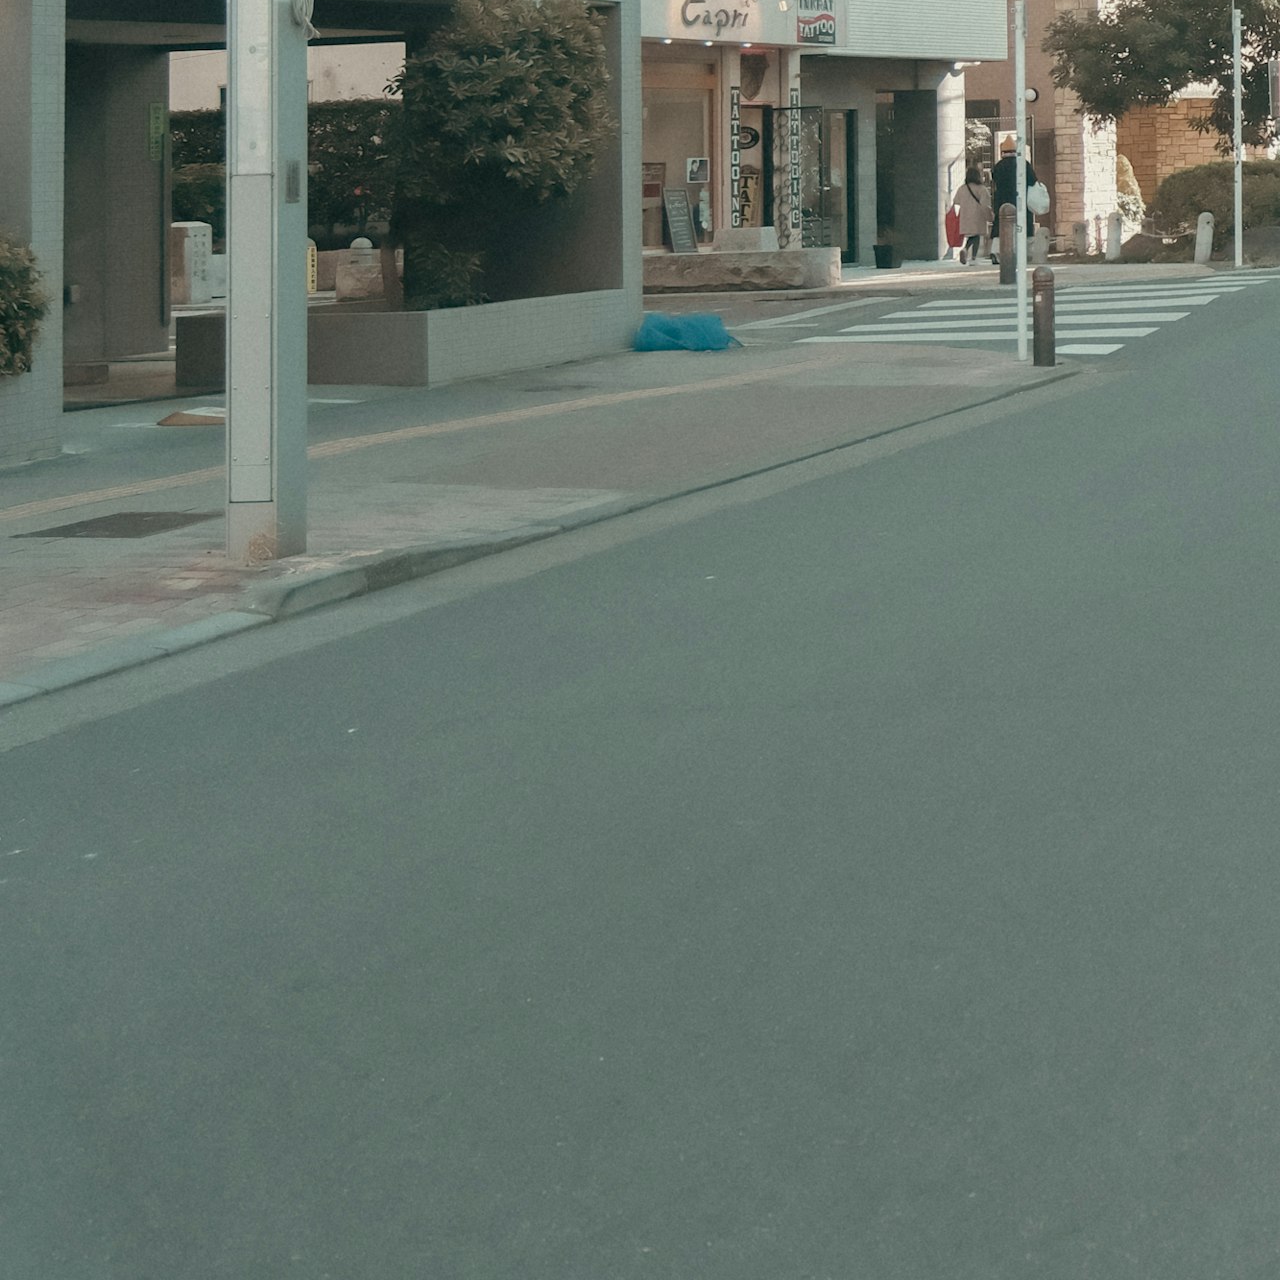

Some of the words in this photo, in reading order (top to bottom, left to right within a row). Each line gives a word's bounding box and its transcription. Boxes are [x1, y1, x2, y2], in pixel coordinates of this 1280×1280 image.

[798, 19, 835, 38] TATTOO
[731, 89, 741, 227] TATTOOING
[790, 90, 801, 224] TATTOOING
